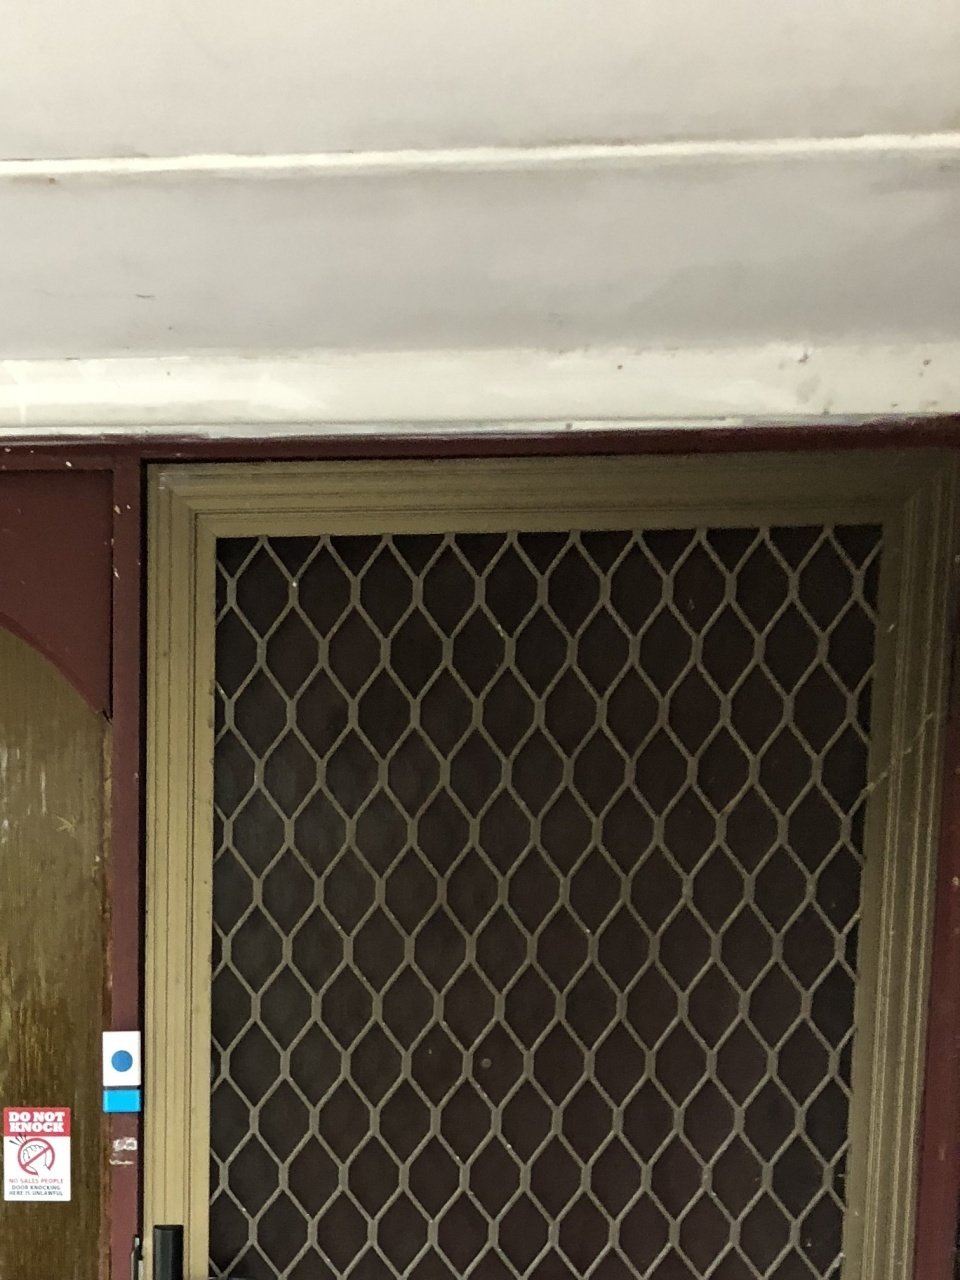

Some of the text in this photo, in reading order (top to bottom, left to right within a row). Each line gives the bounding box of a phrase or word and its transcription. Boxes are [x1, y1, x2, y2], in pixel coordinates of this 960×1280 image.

[8, 1111, 65, 1122] DO NOT
[9, 1122, 65, 1132] KNOCK
